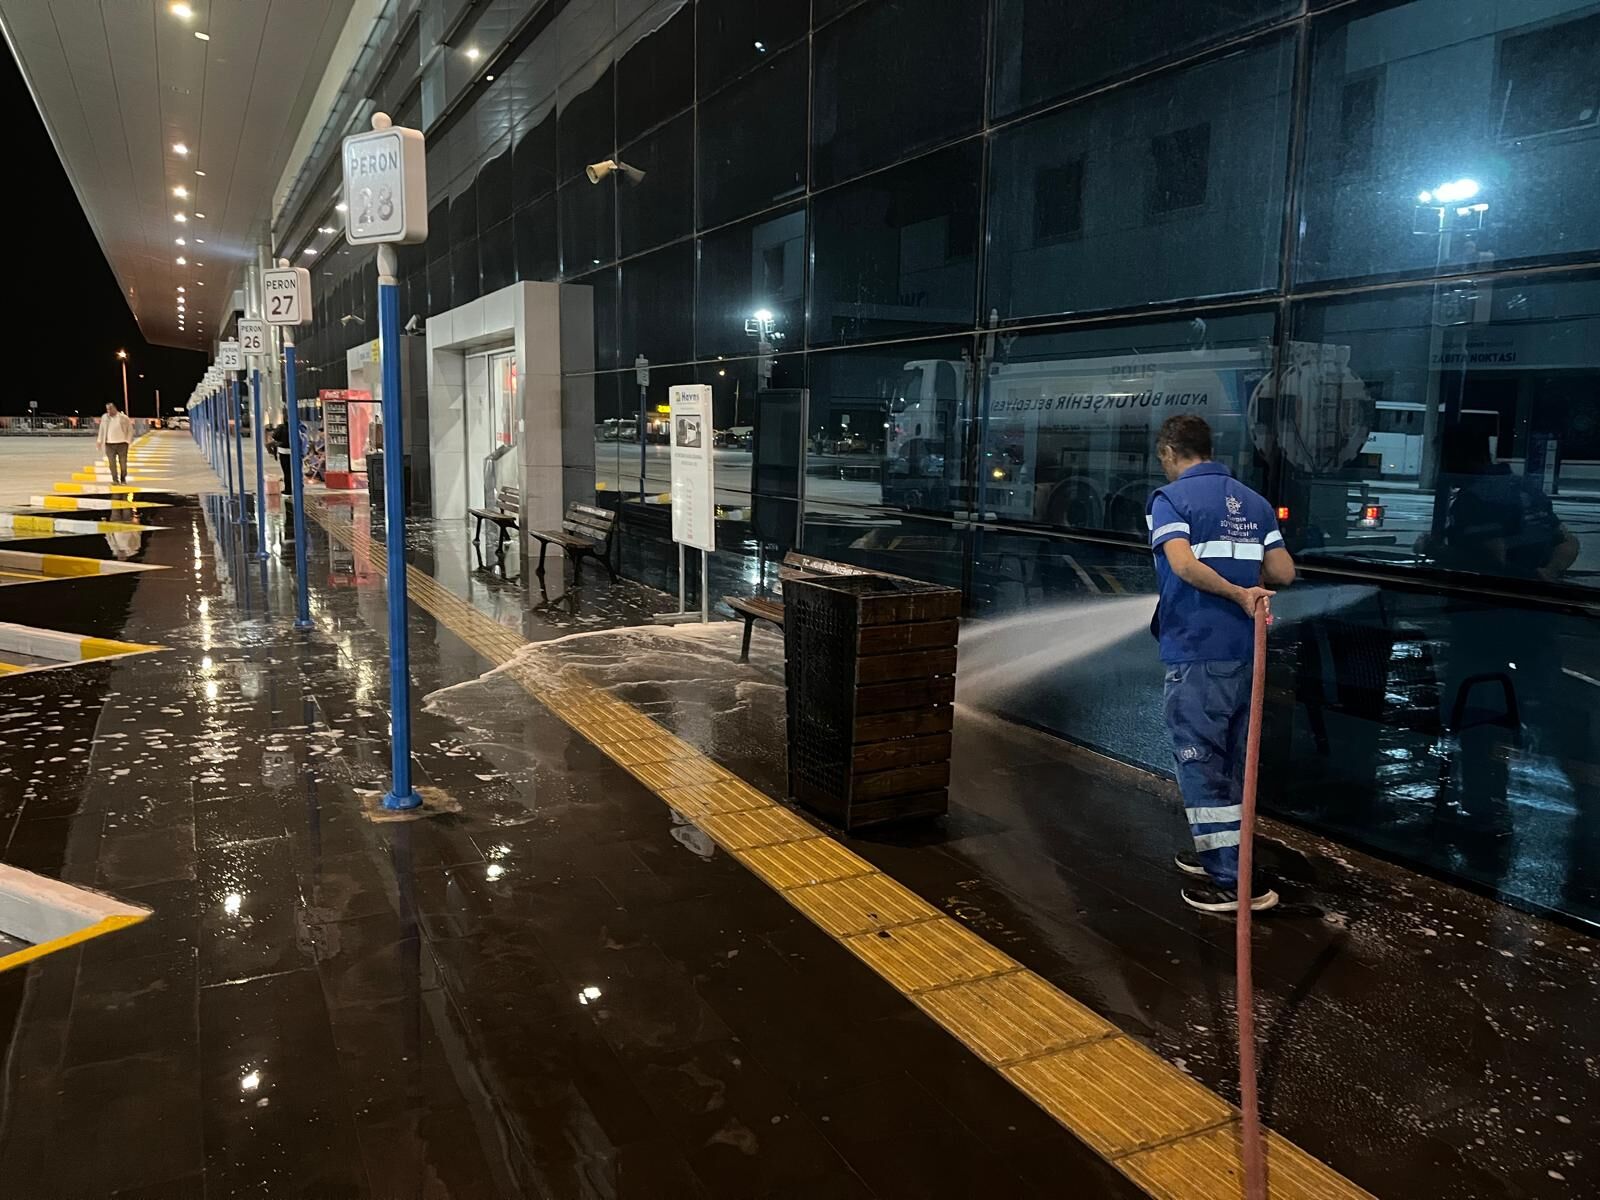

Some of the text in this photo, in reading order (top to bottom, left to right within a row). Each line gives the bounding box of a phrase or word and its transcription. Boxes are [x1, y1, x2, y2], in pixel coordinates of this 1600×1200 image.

[351, 150, 398, 177] PERON
[358, 186, 394, 225] 28
[265, 278, 297, 291] PERON
[271, 296, 293, 316] 27
[244, 336, 261, 349] 26
[225, 355, 237, 365] 25
